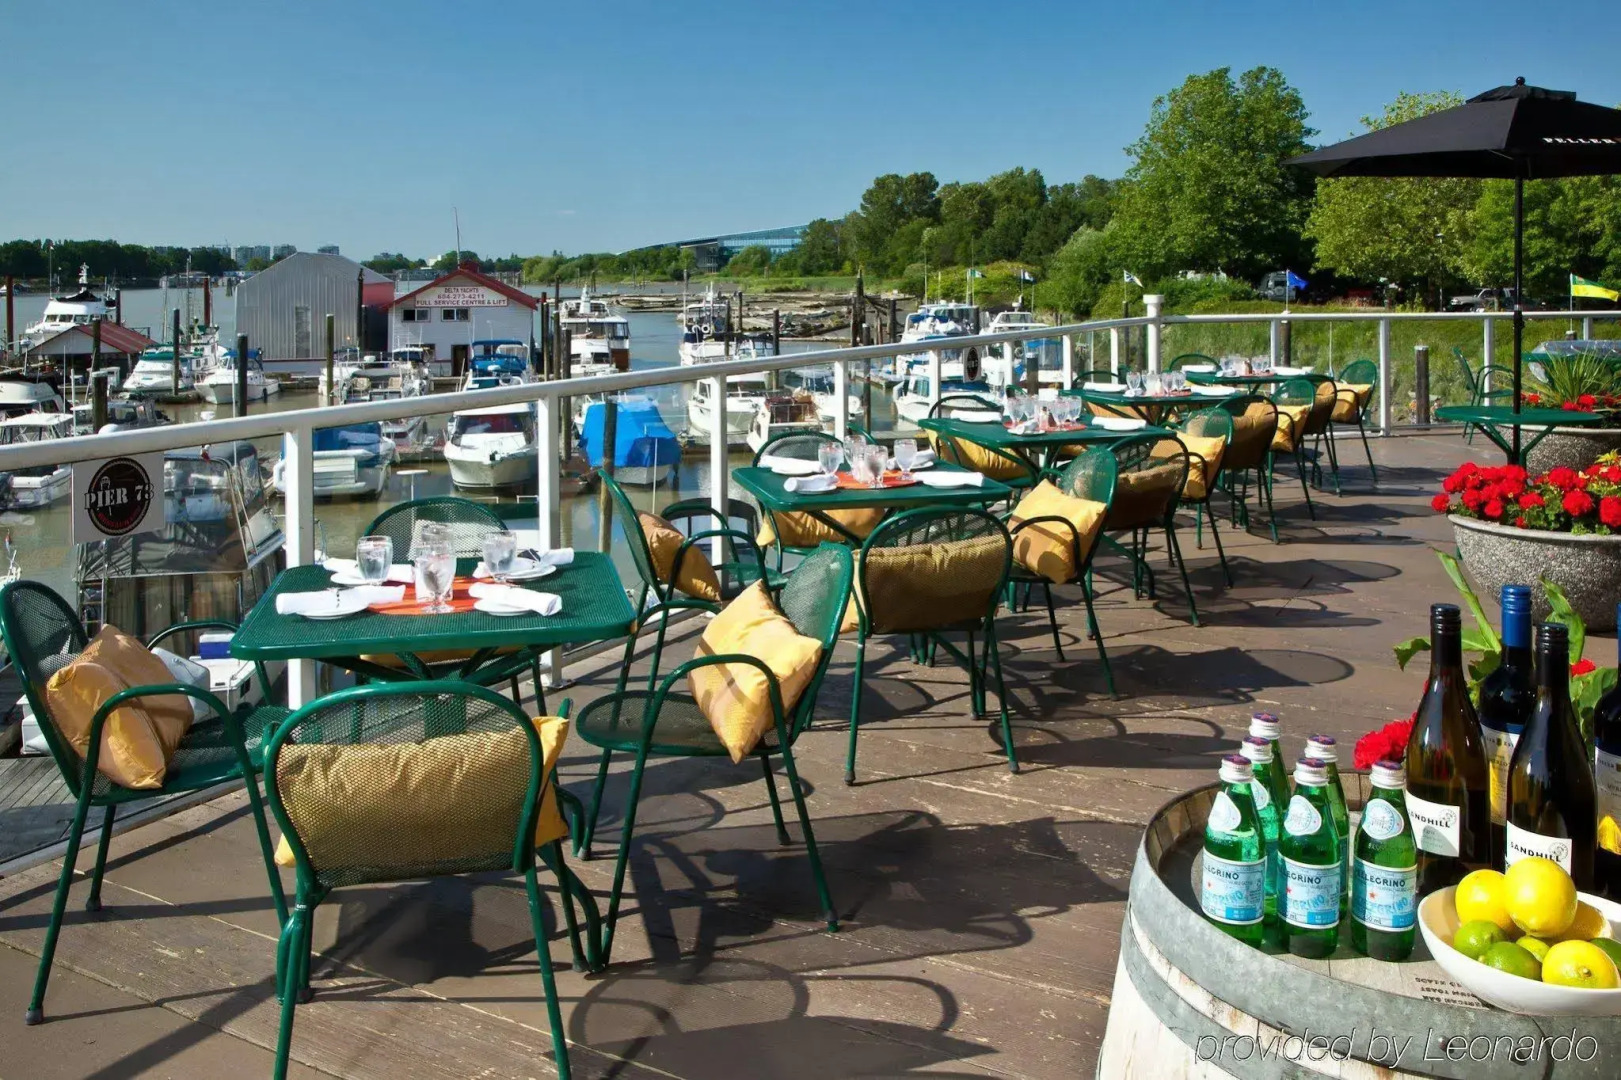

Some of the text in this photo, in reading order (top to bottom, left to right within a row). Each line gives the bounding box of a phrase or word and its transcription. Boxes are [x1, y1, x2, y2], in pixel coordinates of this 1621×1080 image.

[84, 483, 155, 510] PIER 73
[1510, 841, 1562, 862] SANDHILL
